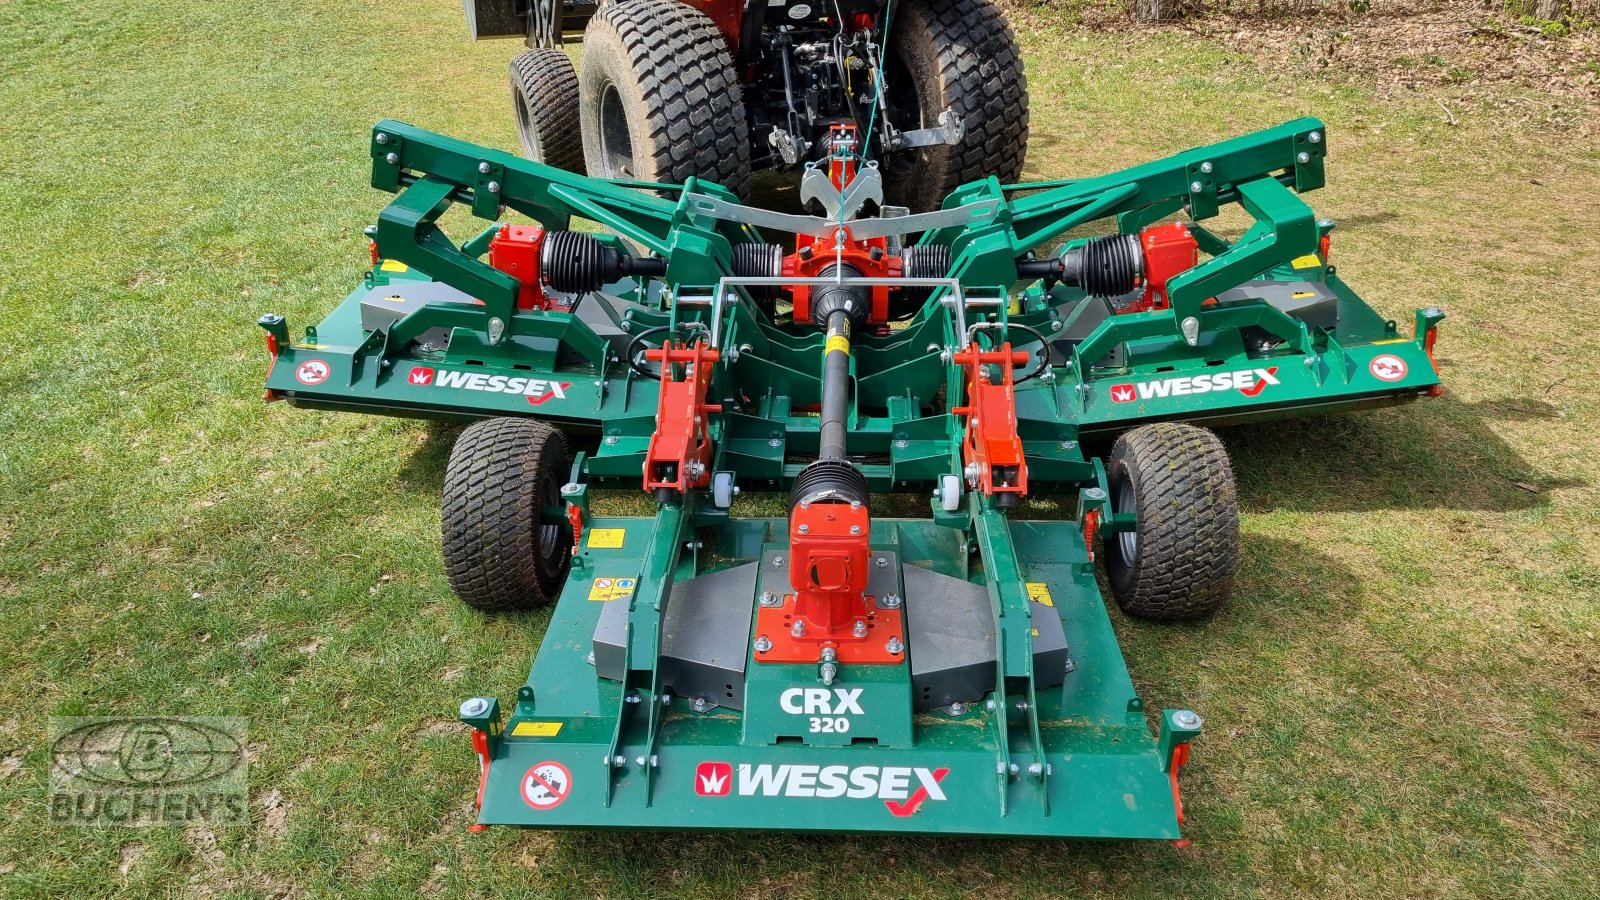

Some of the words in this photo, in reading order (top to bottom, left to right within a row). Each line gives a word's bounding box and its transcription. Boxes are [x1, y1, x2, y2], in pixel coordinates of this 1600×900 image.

[436, 370, 572, 405] WESSEX
[1138, 367, 1281, 400] WESSEX
[780, 688, 865, 714] CRX
[809, 717, 849, 733] 320
[738, 764, 950, 817] WESSEX
